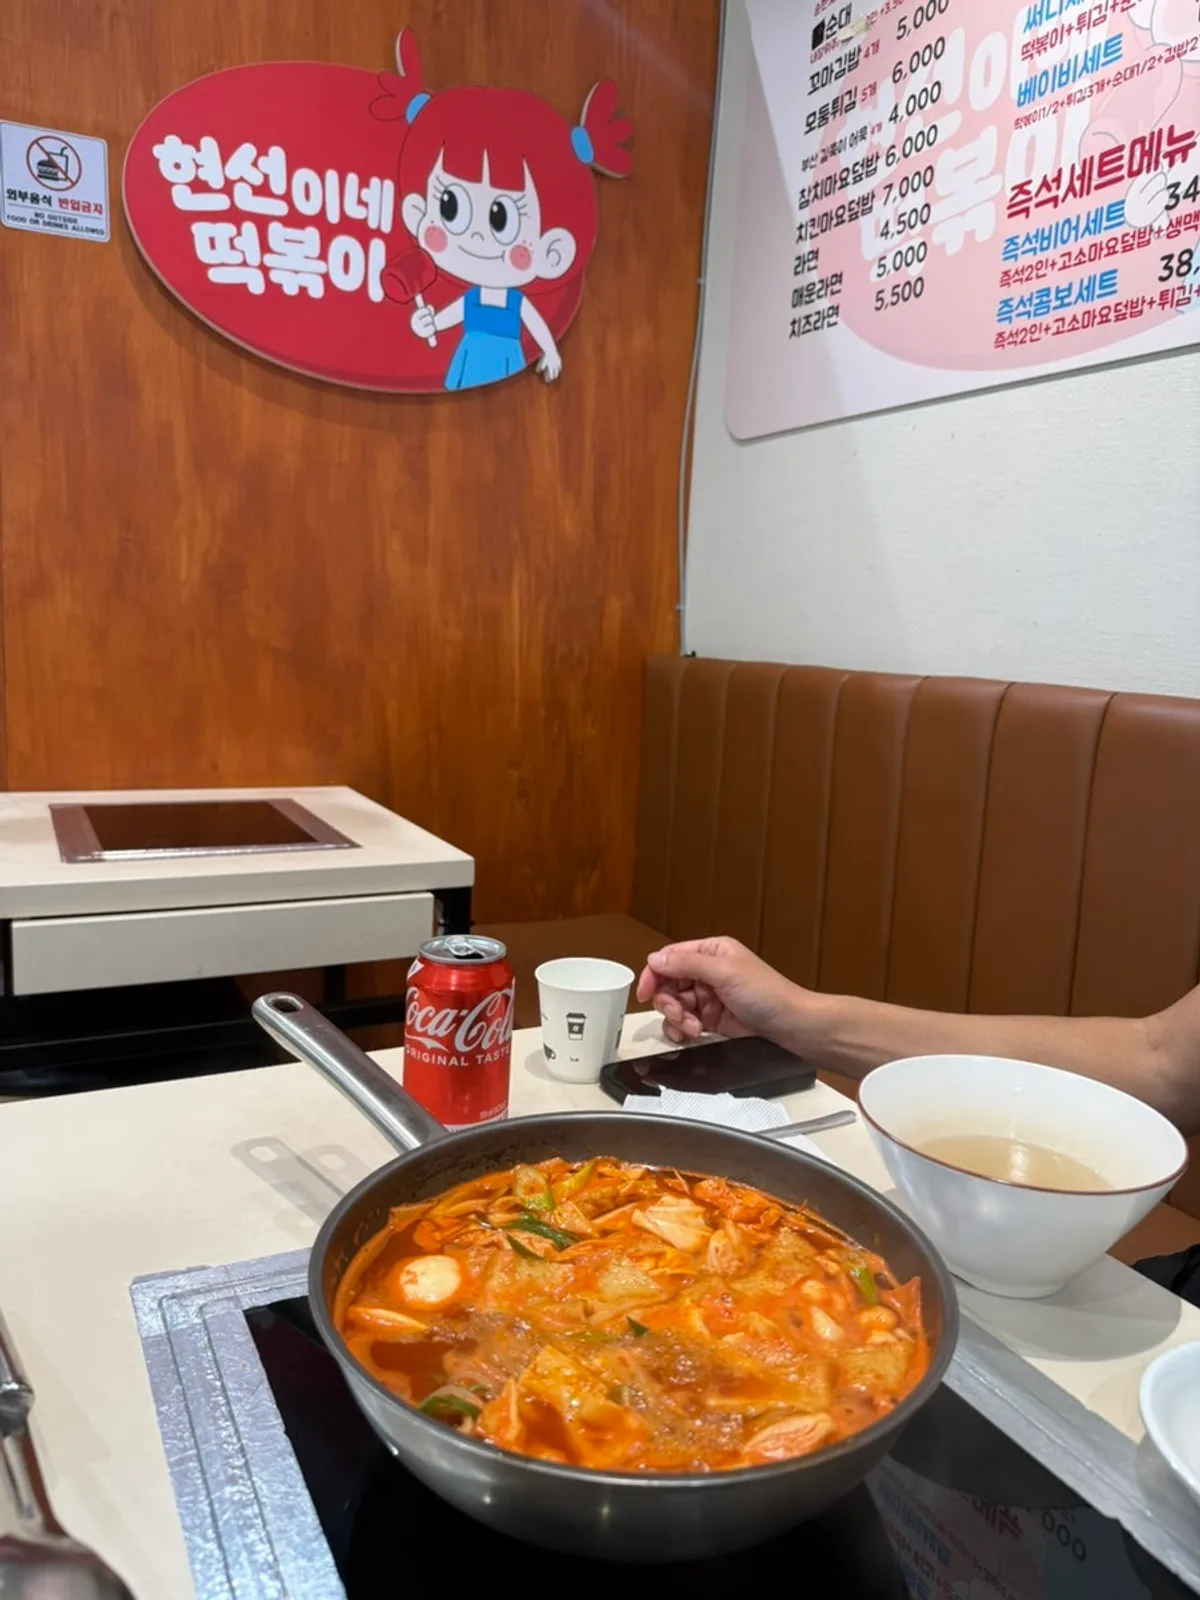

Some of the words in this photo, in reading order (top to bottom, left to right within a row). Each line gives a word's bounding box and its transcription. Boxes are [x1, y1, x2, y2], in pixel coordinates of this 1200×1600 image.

[896, 0, 950, 40] 5,000
[807, 44, 861, 96] 꼬마김밥
[892, 36, 945, 84] 6,000
[1016, 32, 1123, 108] 베이비세트
[804, 86, 858, 135] 모둠튀김
[888, 81, 941, 125] 4,000
[152, 134, 395, 234] 현선이네
[798, 151, 880, 211] 참치마요덮밥
[885, 124, 938, 168] 6,000
[1006, 124, 1197, 219] 즉석세트메뉴
[6, 188, 52, 207] 외부음식
[57, 197, 103, 215] 반입금지
[795, 190, 875, 245] 치킨마요덮밥
[883, 165, 934, 206] 7,000
[880, 202, 931, 241] 4,500
[1001, 199, 1126, 263] 즉석비어세트
[191, 221, 386, 303] 떡볶이
[794, 247, 819, 277] 라면
[876, 241, 928, 279] 5,000
[791, 271, 843, 309] 매운라면
[874, 276, 925, 312] 5,500
[995, 268, 1119, 326] 즉석콤보세트
[789, 303, 840, 340] 치즈라면
